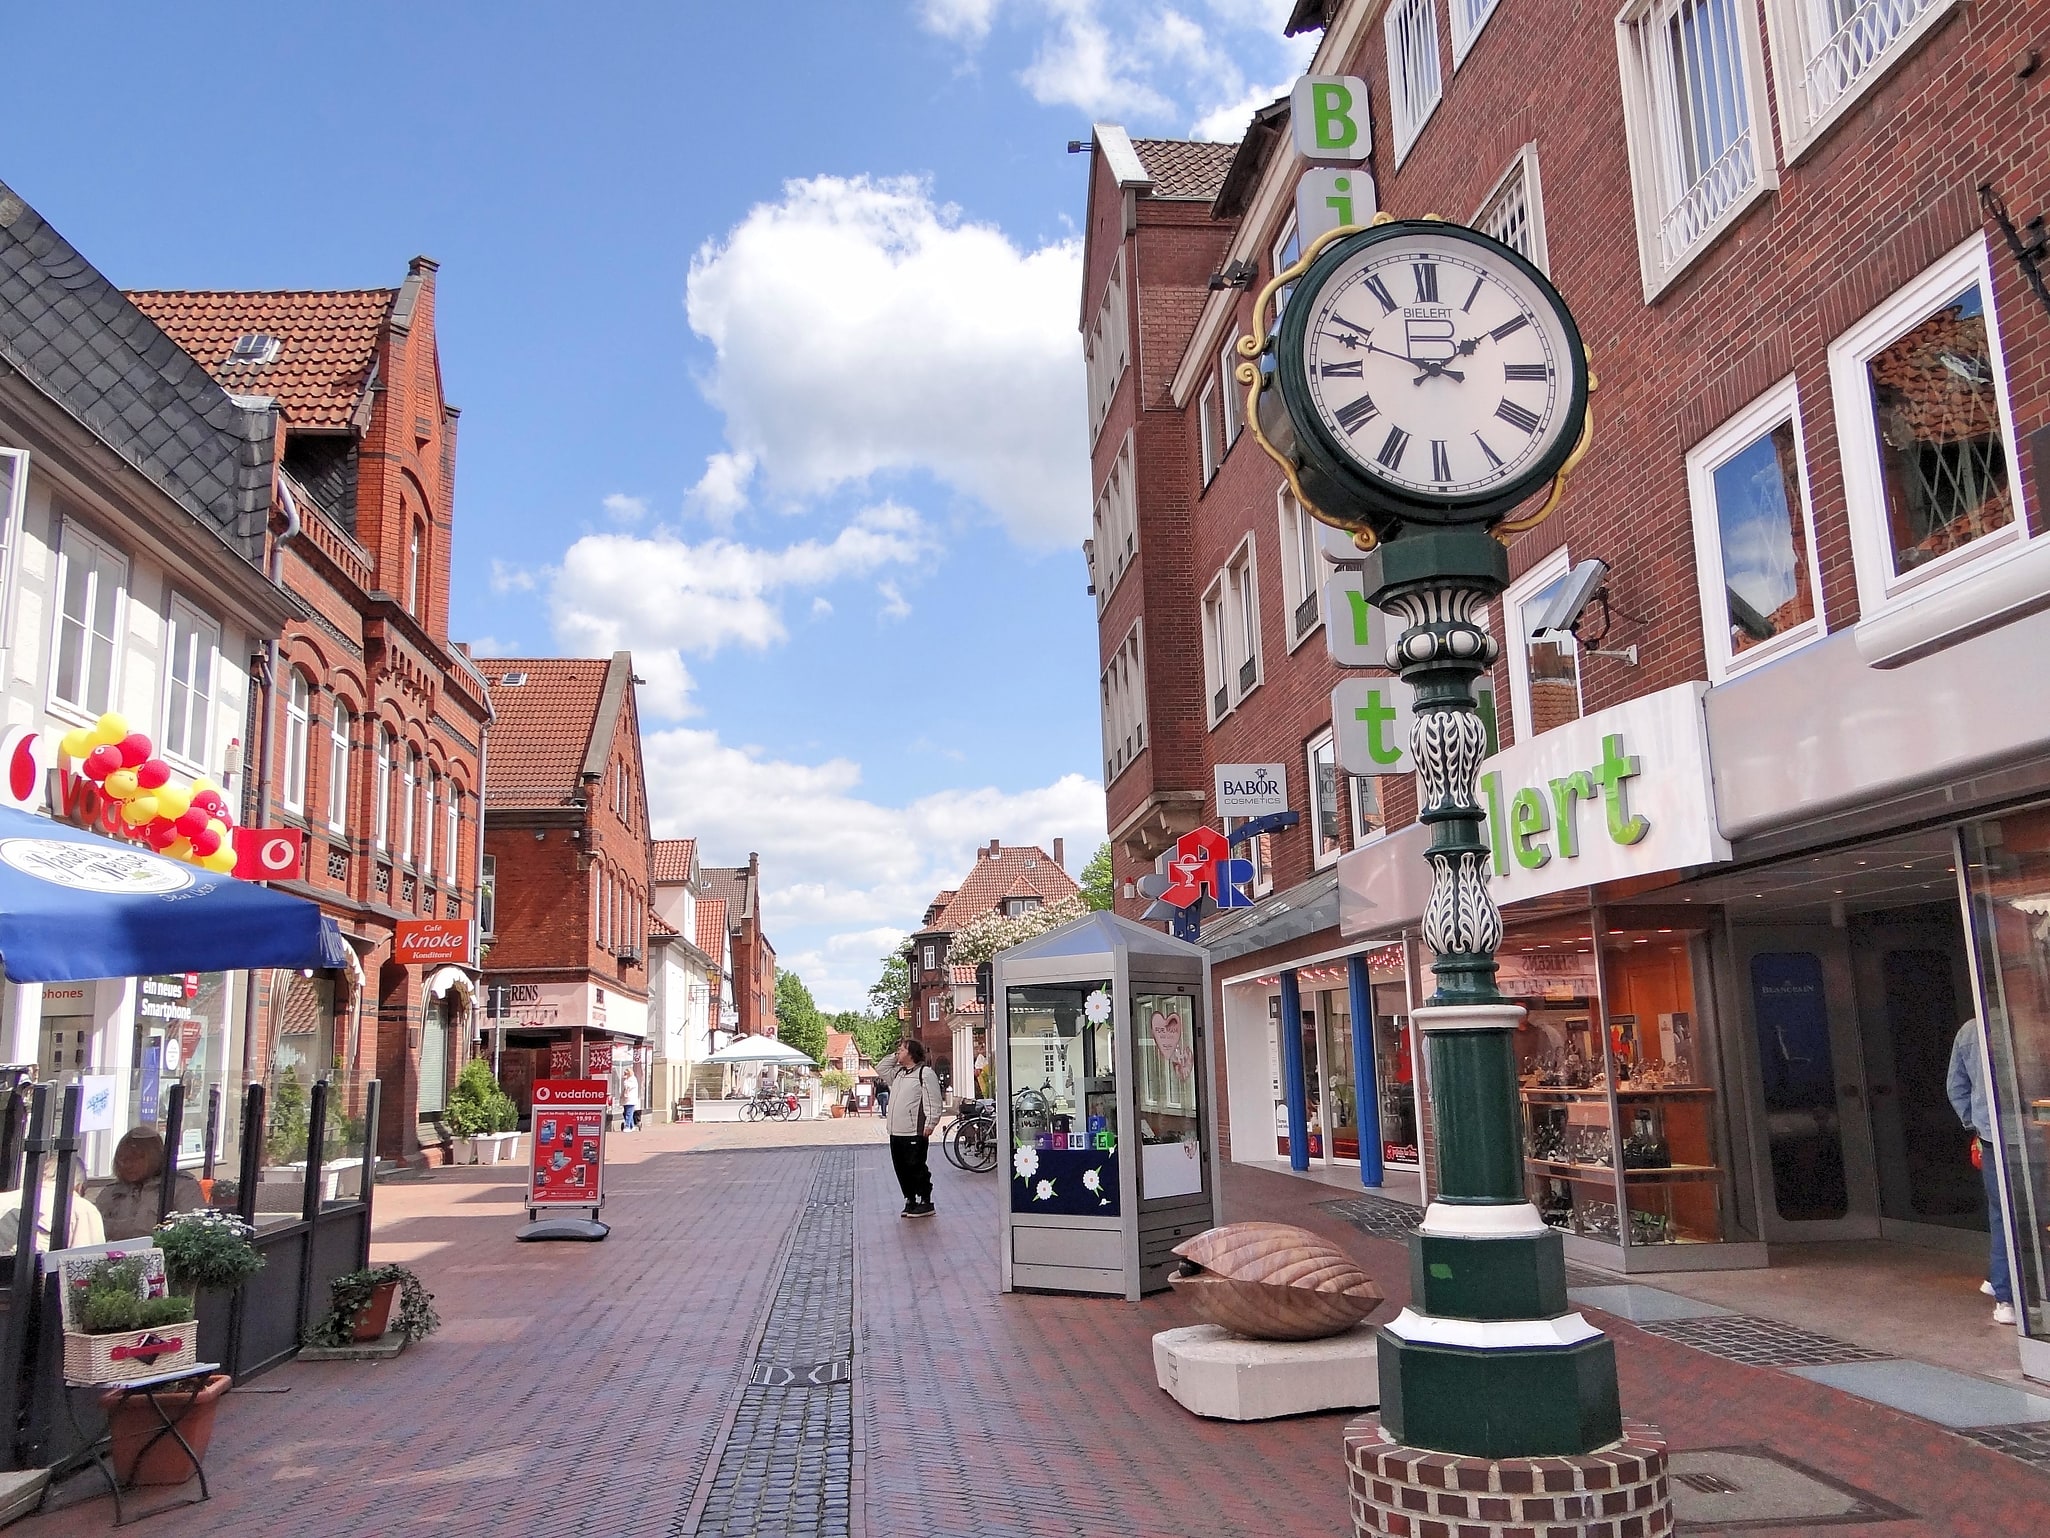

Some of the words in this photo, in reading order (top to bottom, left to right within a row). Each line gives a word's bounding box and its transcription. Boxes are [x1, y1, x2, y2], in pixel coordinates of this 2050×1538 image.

[1410, 263, 1443, 304] XII
[1403, 308, 1453, 319] BIELERT
[1223, 780, 1280, 798] BABOR
[1224, 797, 1281, 805] COSMETICS
[1480, 733, 1651, 884] lert
[402, 932, 463, 949] Knoke
[413, 951, 452, 960] Konditorei
[143, 977, 157, 995] ein
[157, 982, 183, 998] neues
[509, 984, 539, 1001] RENS
[141, 998, 191, 1022] Smartphone
[554, 1089, 605, 1099] vodafone
